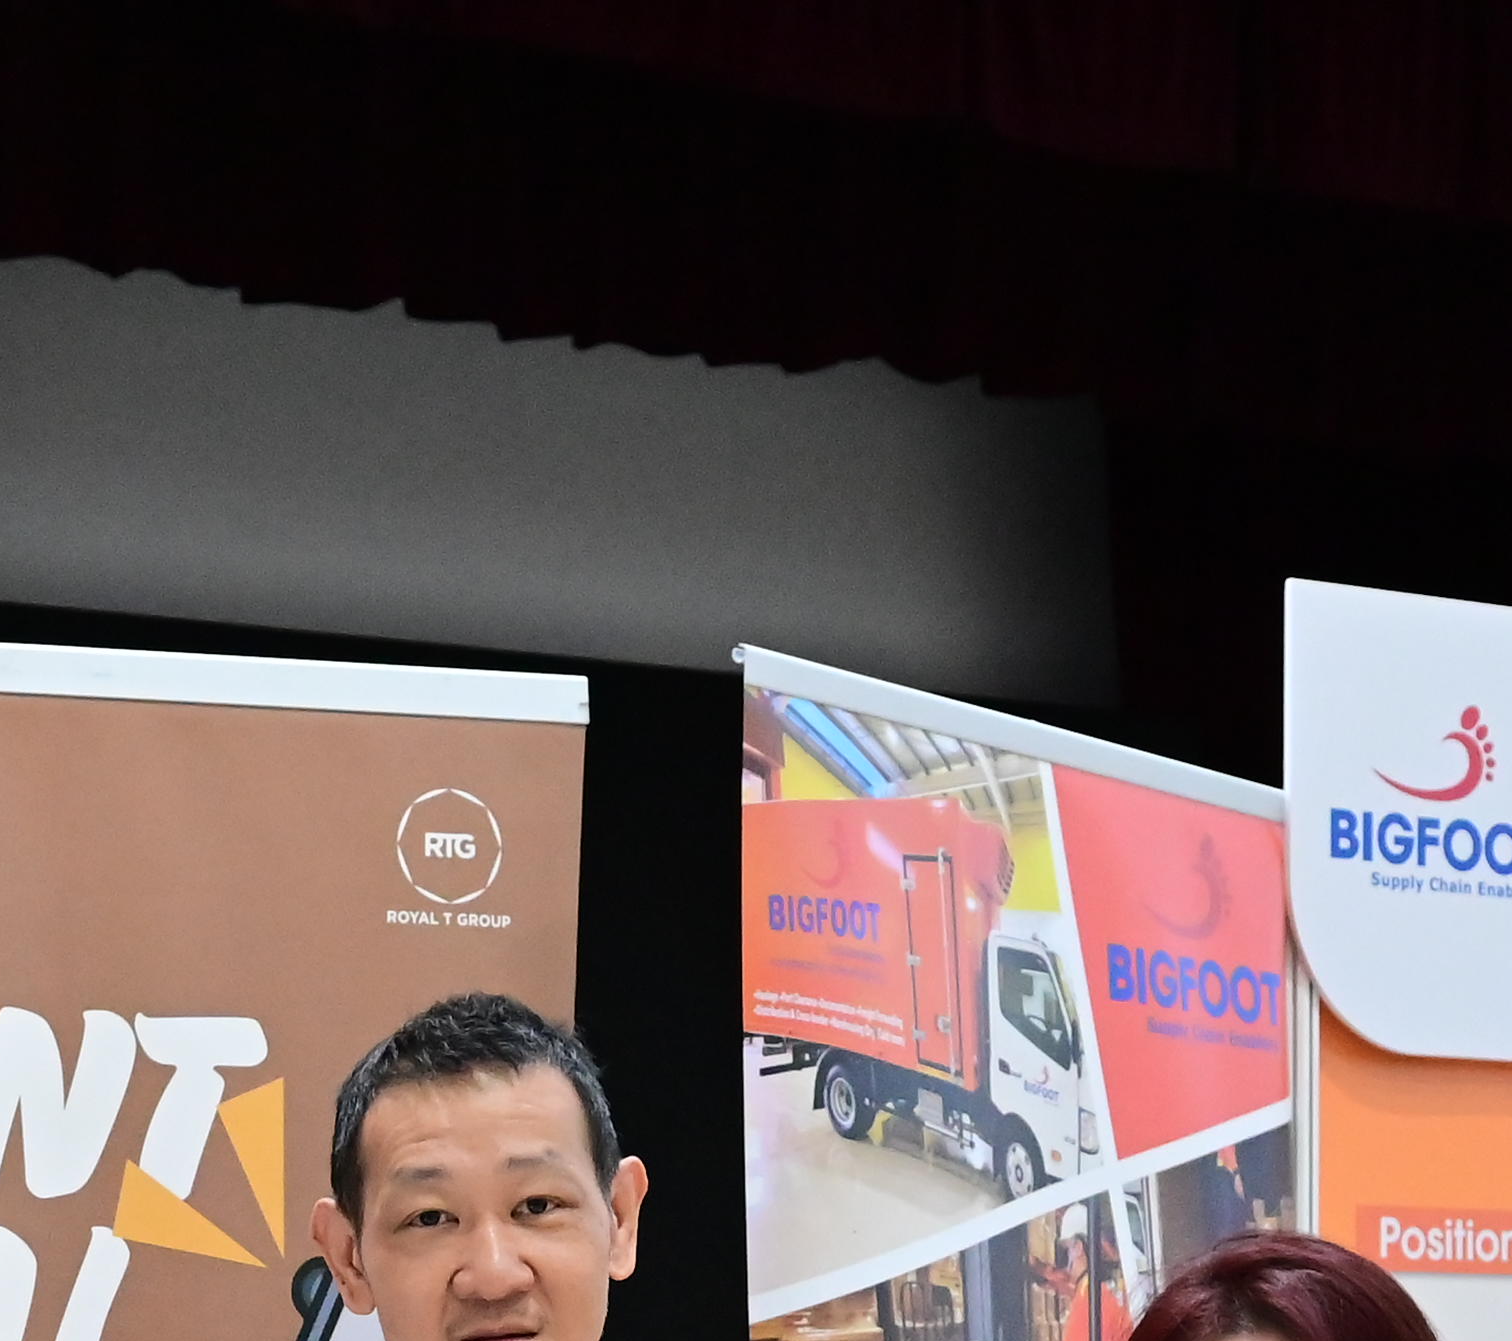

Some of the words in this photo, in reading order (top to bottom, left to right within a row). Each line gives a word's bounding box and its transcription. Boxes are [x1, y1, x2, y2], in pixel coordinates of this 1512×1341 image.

[424, 831, 477, 859] RTG
[1370, 871, 1424, 894] Supply
[1429, 877, 1473, 895] Chain
[386, 909, 439, 926] ROYAL
[442, 912, 453, 926] T
[456, 913, 512, 929] GROUP
[767, 893, 882, 944] BIGFOOT
[1106, 942, 1282, 1027] BIGFOOT
